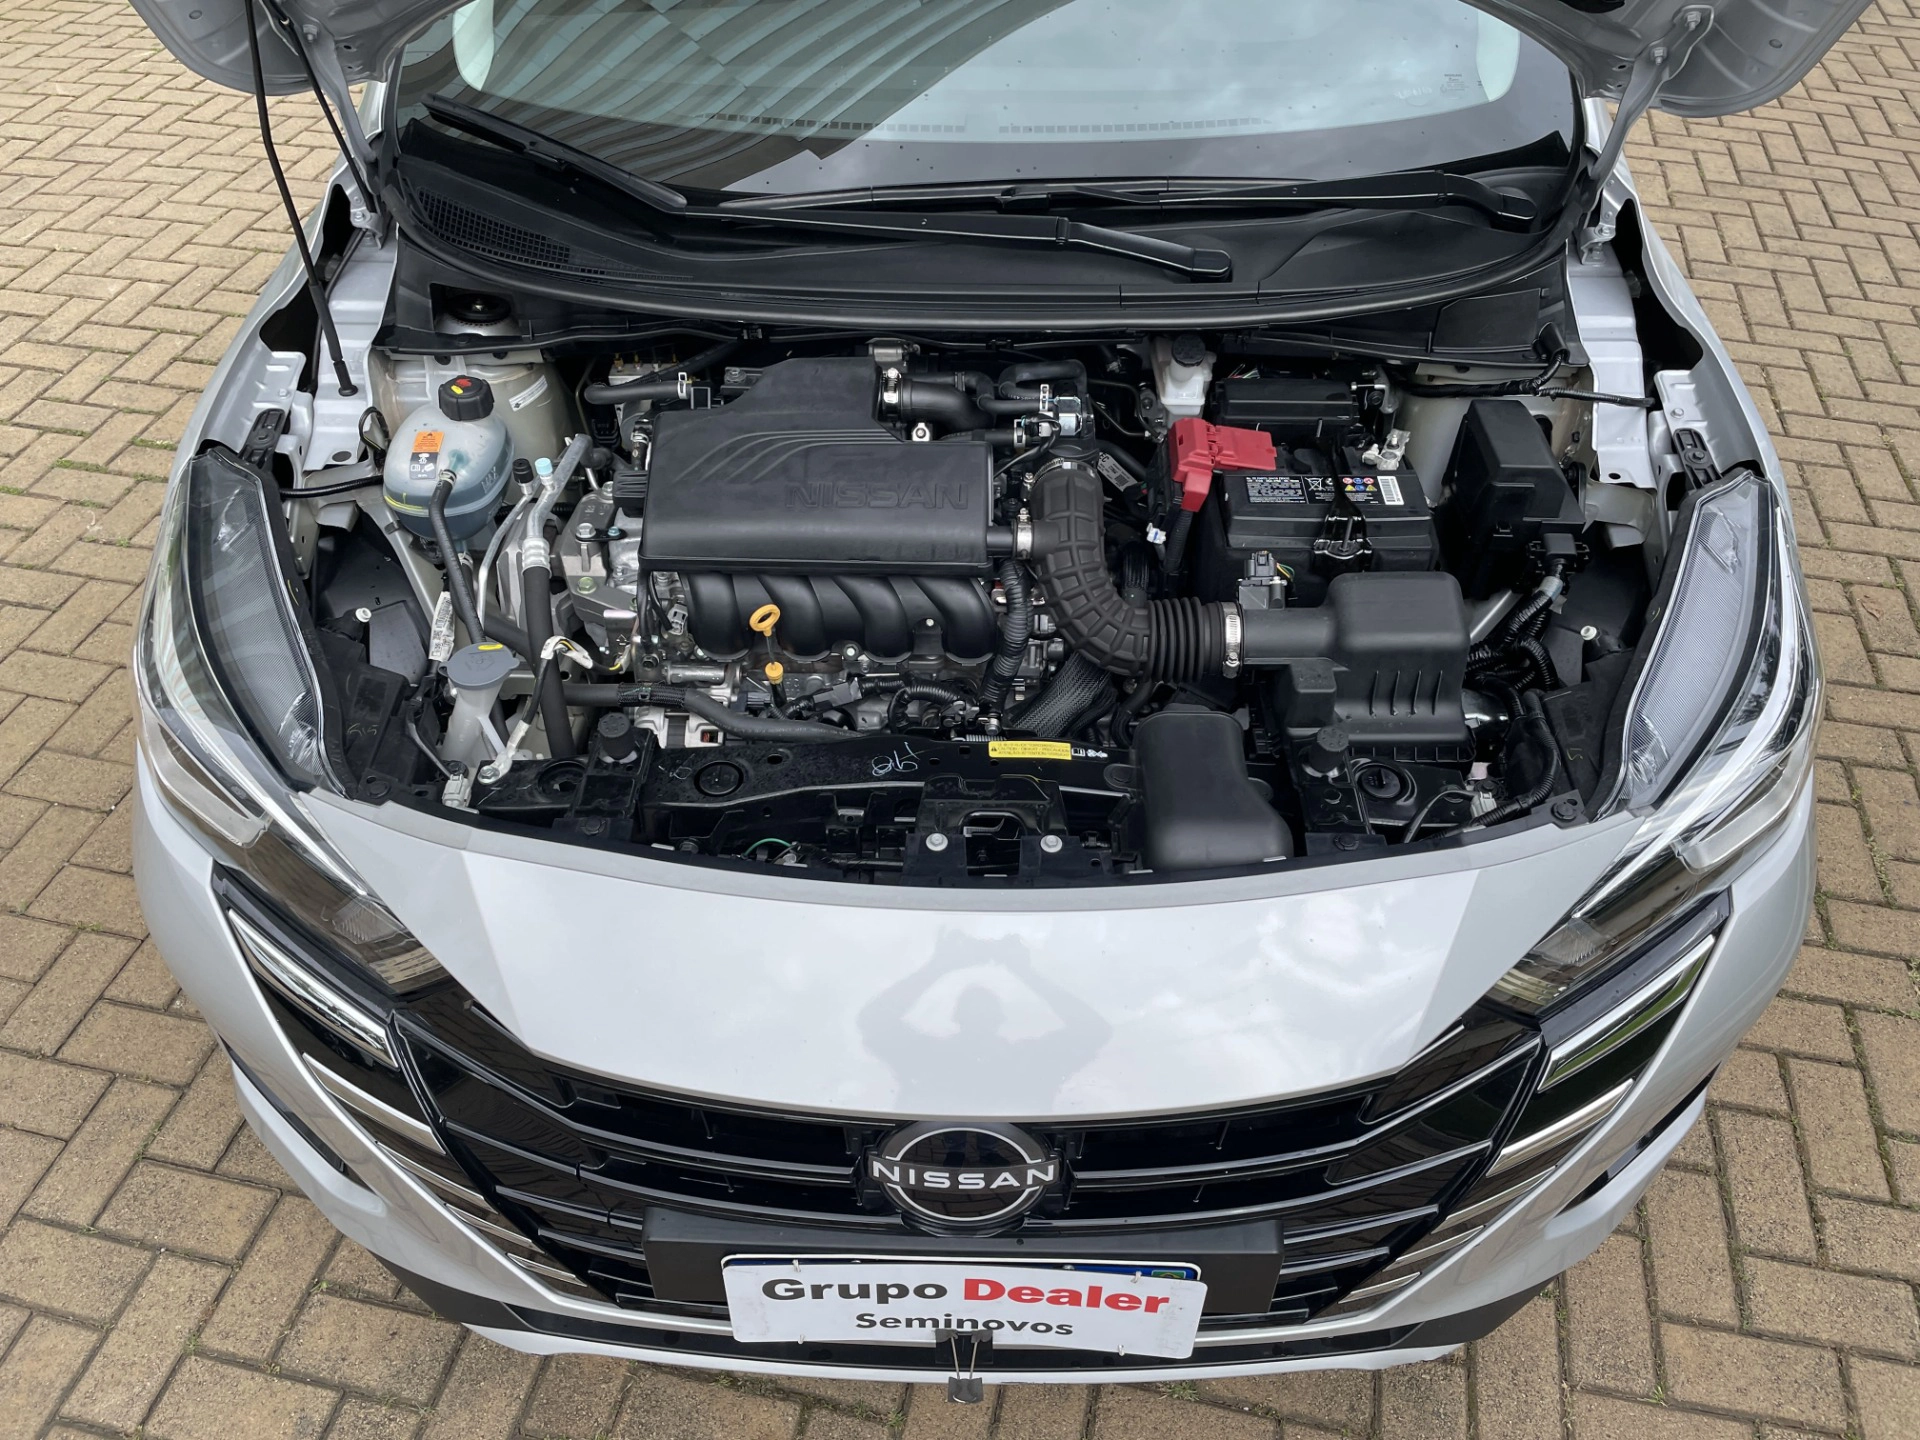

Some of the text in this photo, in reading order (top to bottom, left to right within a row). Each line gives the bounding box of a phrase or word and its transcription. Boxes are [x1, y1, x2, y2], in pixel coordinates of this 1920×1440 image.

[785, 481, 968, 510] NISSAN
[872, 1160, 1054, 1190] NISSAN
[762, 1278, 1170, 1313] Grupo Dealer
[855, 1312, 1074, 1336] Seminovos
